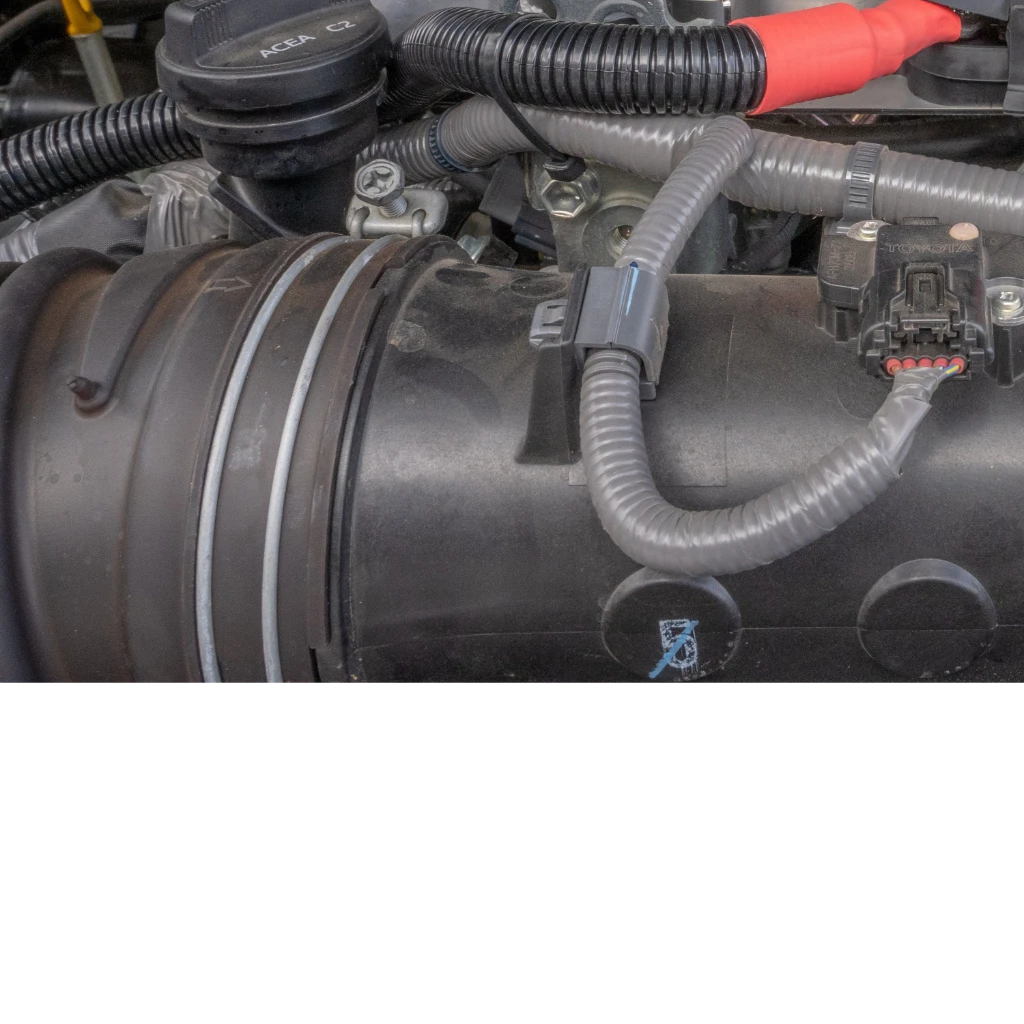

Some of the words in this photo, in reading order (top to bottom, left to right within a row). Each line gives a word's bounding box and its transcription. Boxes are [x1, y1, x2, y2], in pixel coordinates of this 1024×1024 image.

[259, 34, 317, 59] ACEA
[325, 20, 357, 32] C2
[884, 242, 974, 254] TOYOTA
